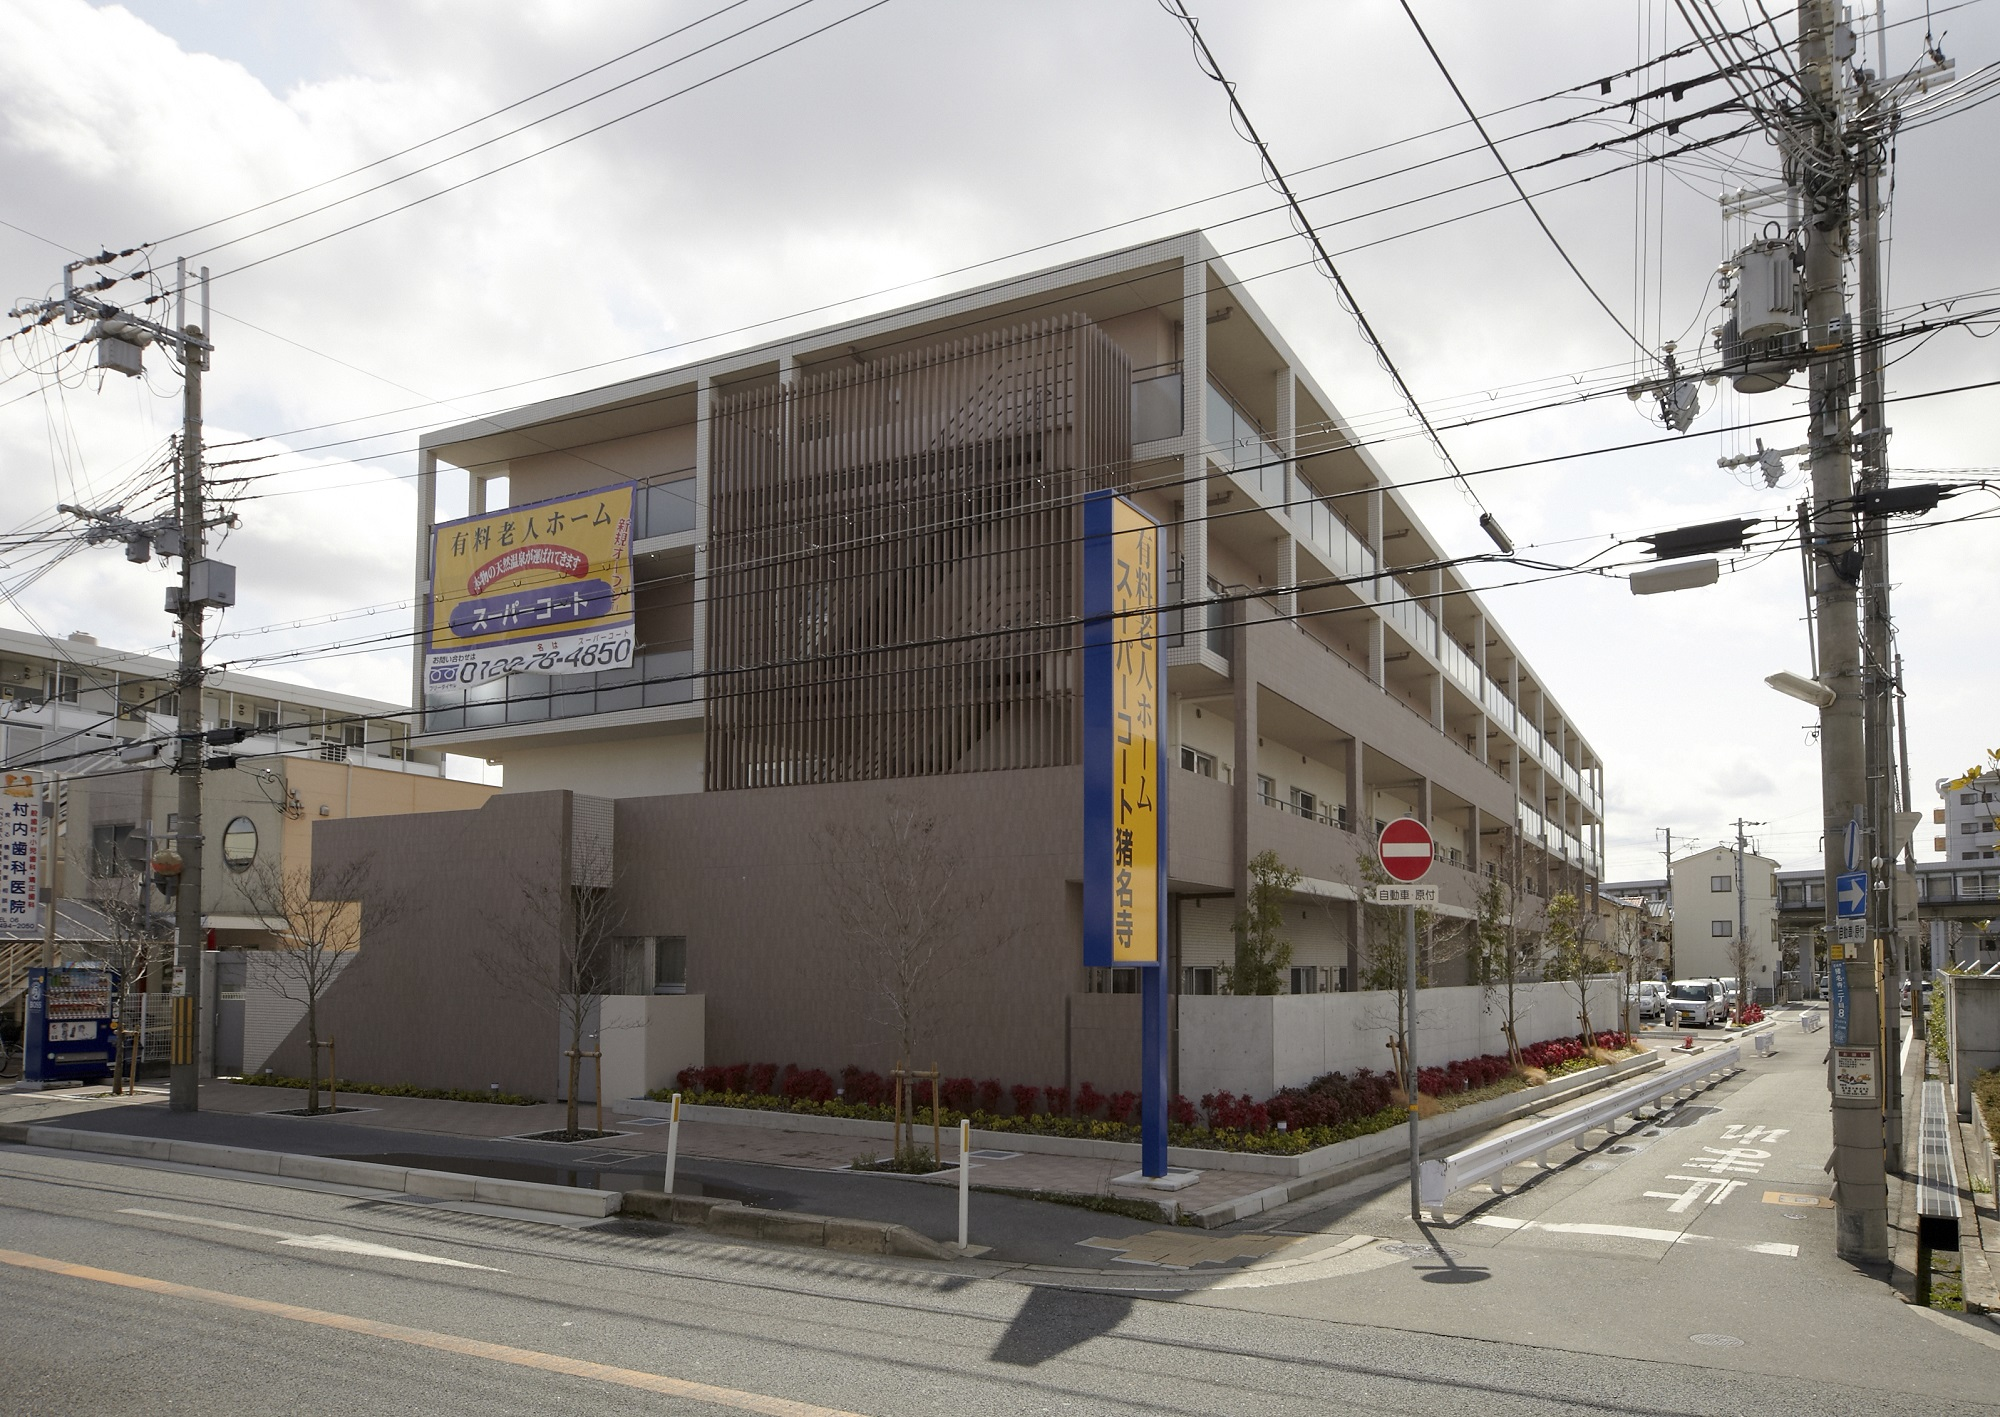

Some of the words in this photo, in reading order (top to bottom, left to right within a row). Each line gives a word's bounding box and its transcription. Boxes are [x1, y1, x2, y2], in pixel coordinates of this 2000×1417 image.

[451, 502, 611, 557] 有料老人ホーム
[474, 547, 582, 588] 本物の天然温泉が運ばれてきます
[472, 591, 588, 631] スーパーコート
[578, 629, 629, 645] スーパーコート
[432, 653, 476, 664] お問い合わせは
[1136, 529, 1152, 812] 有料老人ホーム
[429, 684, 457, 692] フリーダイヤル
[1116, 558, 1133, 949] スーパーコート猪名寺
[10, 802, 29, 914] 村内歯科医院
[0, 922, 35, 930] 494-2050
[29, 1001, 42, 1009] BOSS
